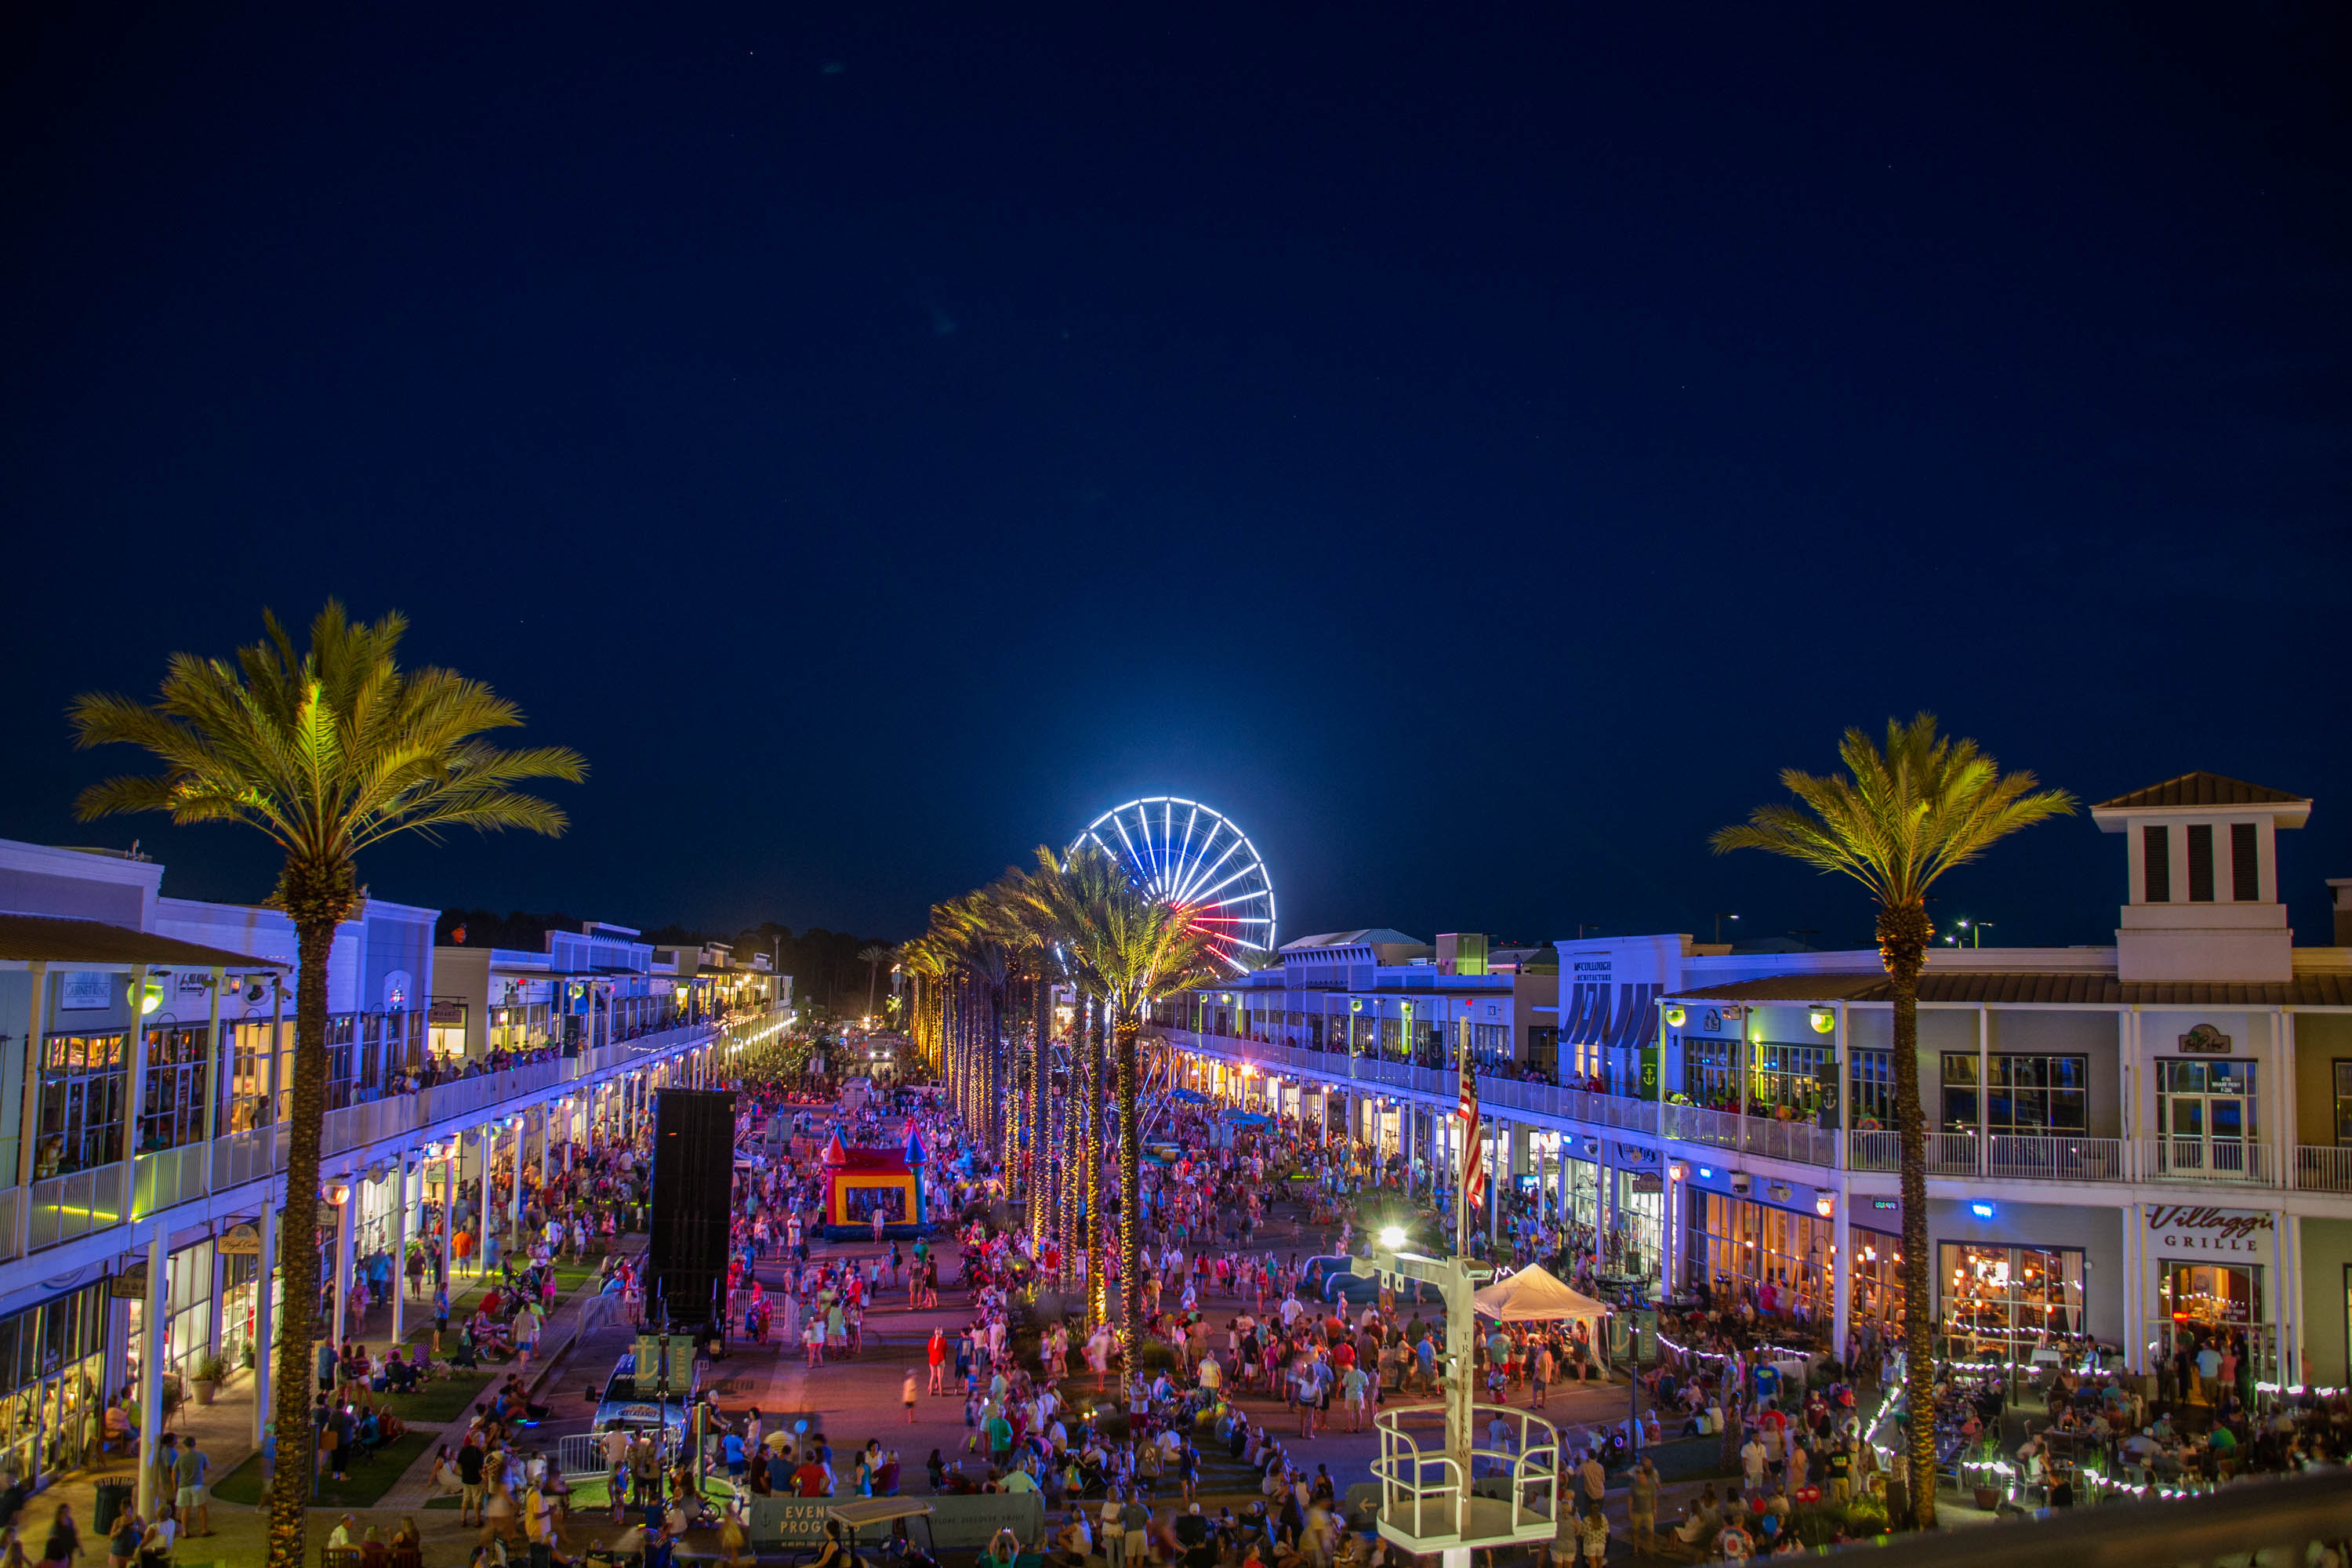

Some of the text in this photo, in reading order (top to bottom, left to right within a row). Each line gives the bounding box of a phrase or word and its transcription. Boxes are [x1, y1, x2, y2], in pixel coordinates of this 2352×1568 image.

[2164, 1235, 2257, 1252] GRILLE
[1643, 1320, 1653, 1356] WHARF
[676, 1346, 687, 1387] WHARF
[1458, 1413, 1469, 1471] CROWN
[779, 1521, 861, 1534] PROGS
